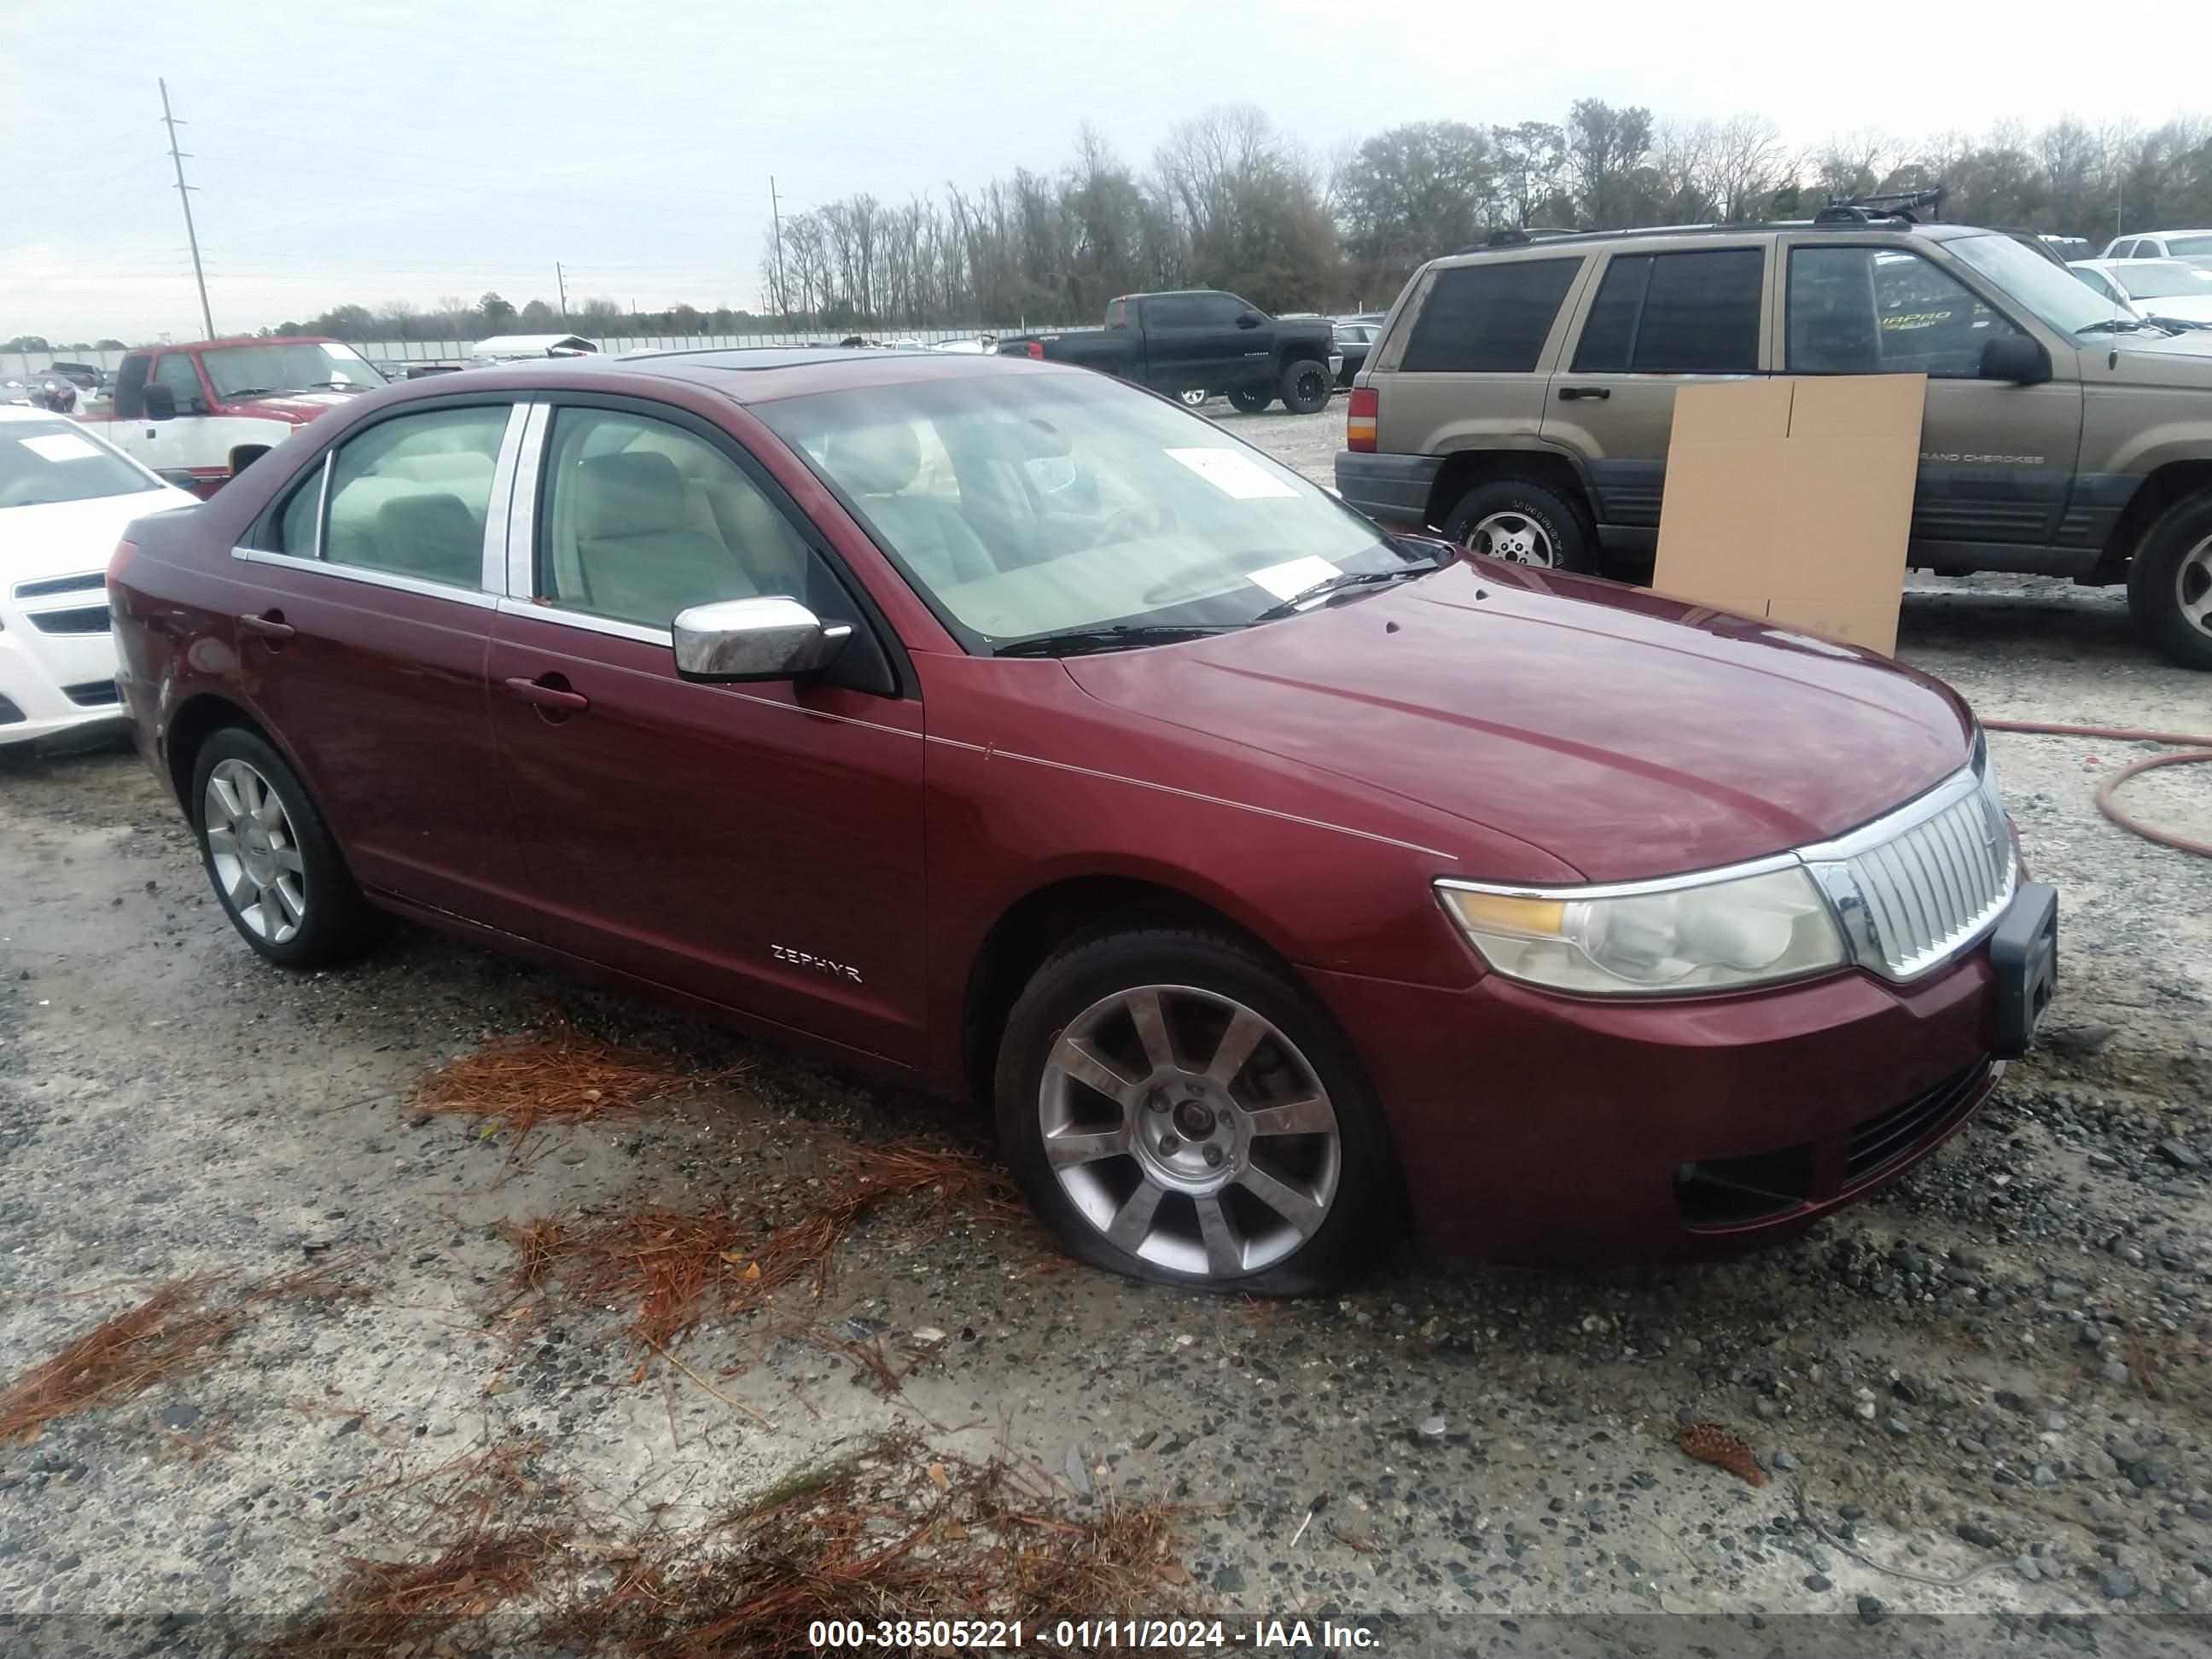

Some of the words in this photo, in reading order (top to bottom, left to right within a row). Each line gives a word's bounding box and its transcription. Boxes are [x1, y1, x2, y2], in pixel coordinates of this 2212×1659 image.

[1919, 452, 1960, 462] RAND
[1963, 454, 2045, 464] CHEROKEE
[771, 944, 863, 983] ZEPHYR
